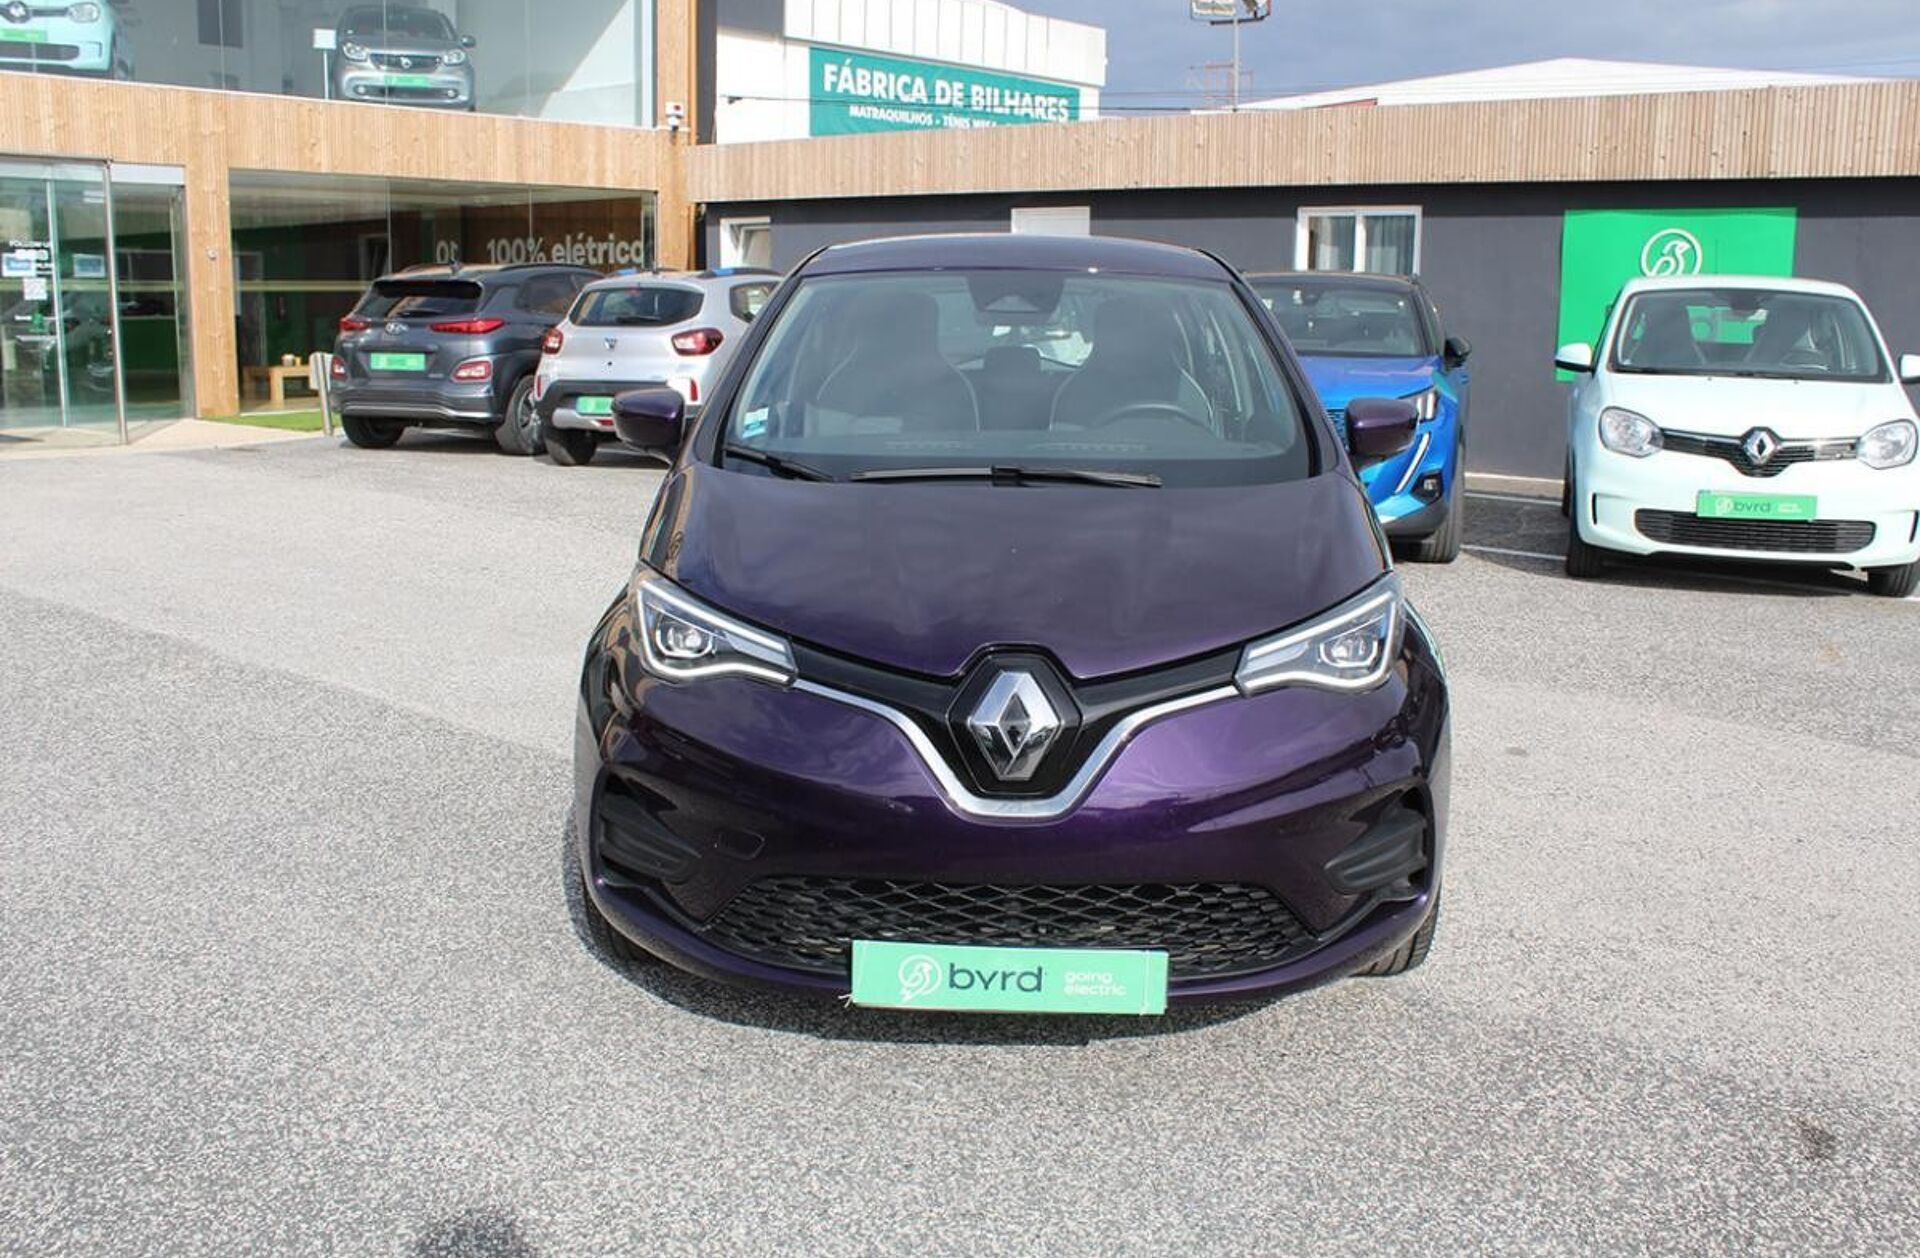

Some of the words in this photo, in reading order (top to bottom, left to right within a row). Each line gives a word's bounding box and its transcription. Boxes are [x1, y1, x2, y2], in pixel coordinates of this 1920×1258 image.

[823, 59, 928, 105] FÁBRICA
[935, 79, 964, 109] DE
[971, 84, 1069, 122] BILHARES
[487, 237, 546, 264] 100%
[552, 232, 642, 265] elétrico
[1064, 970, 1113, 984] going
[1064, 983, 1128, 997] electric
